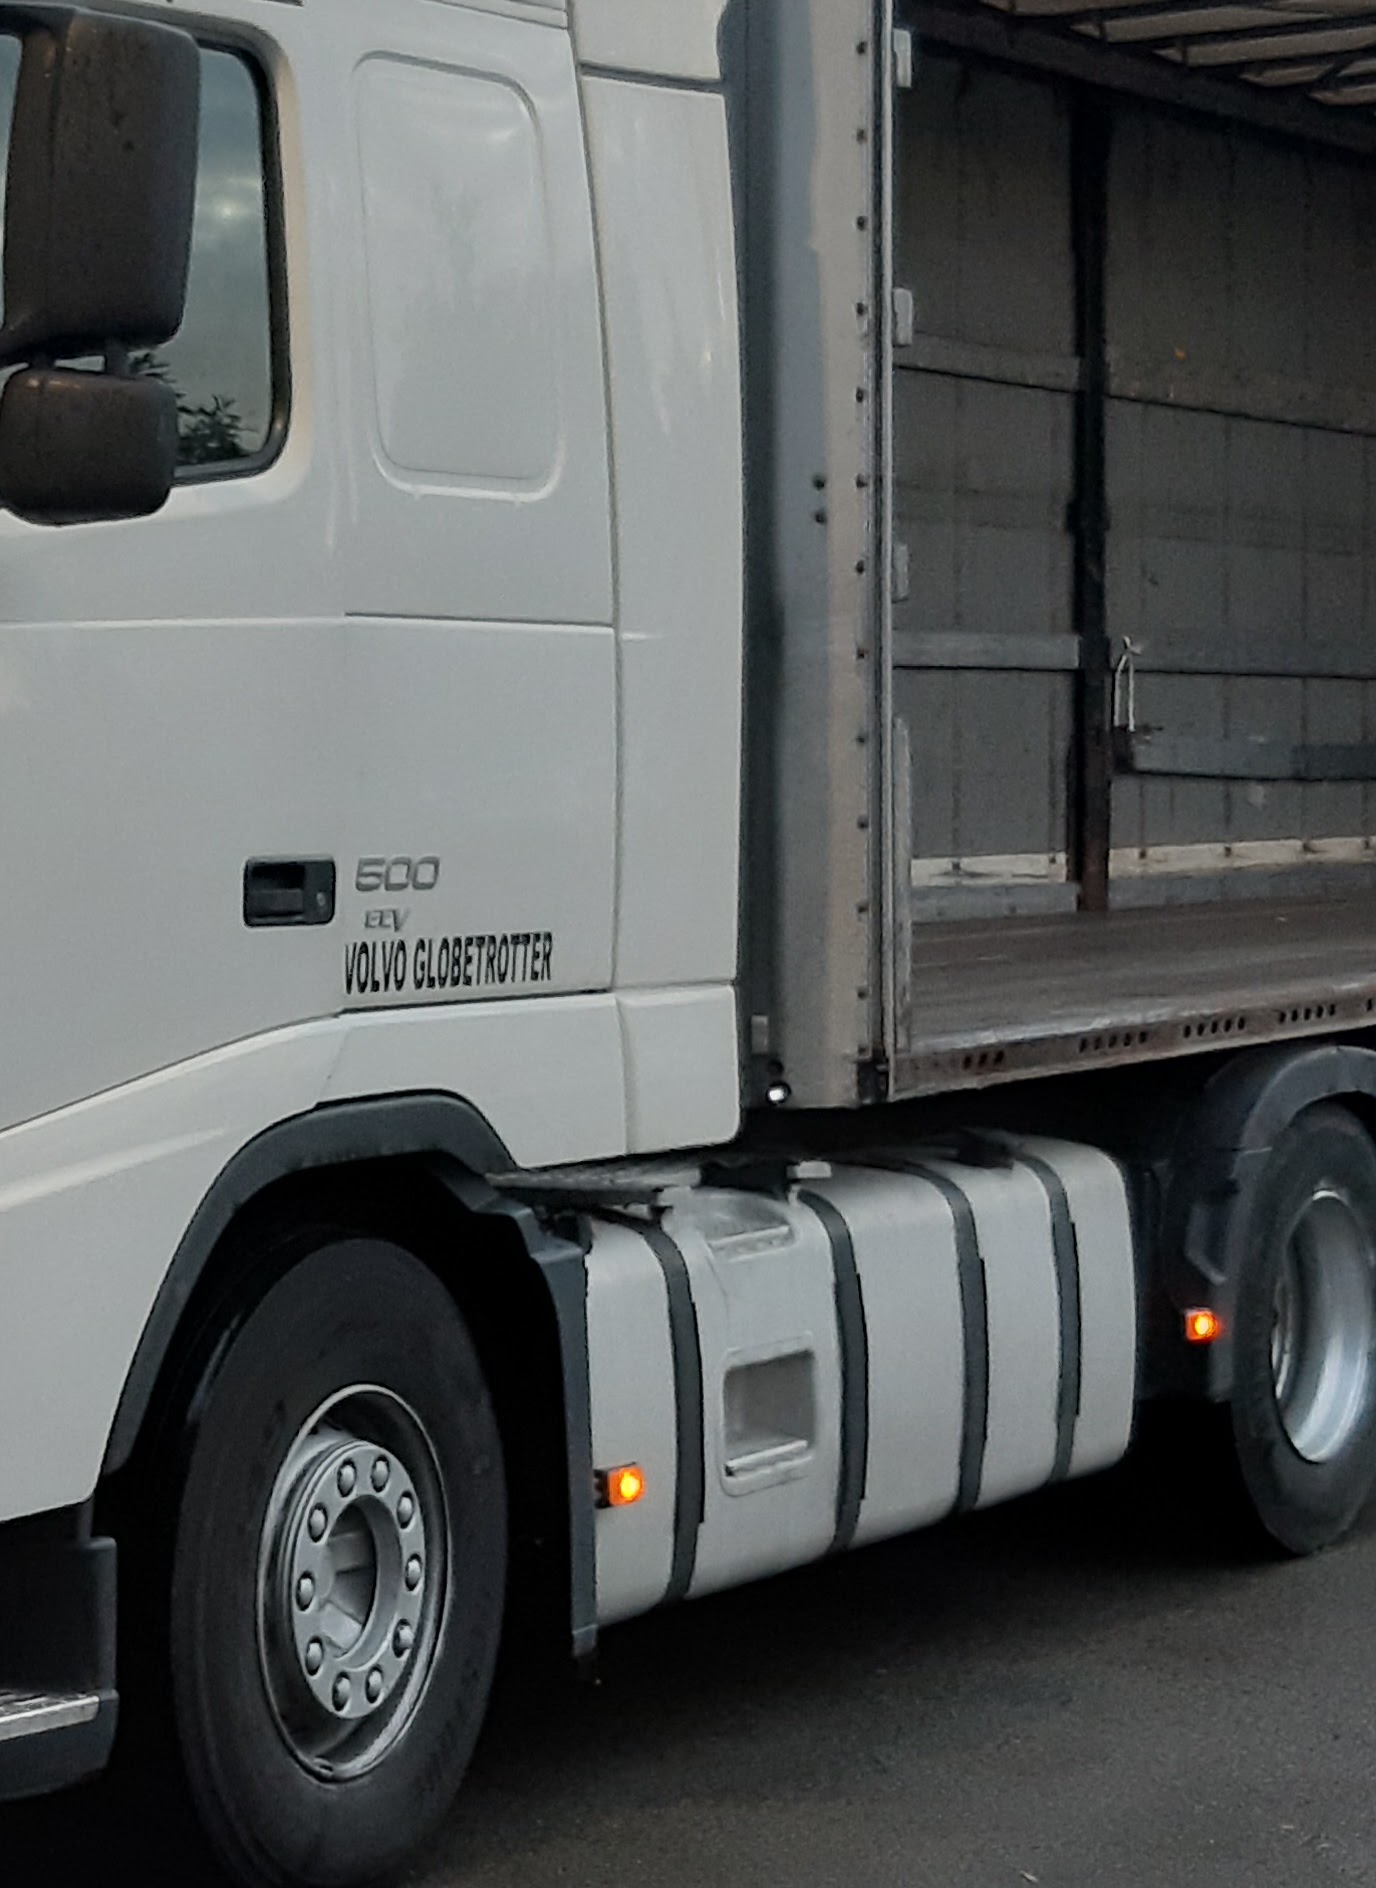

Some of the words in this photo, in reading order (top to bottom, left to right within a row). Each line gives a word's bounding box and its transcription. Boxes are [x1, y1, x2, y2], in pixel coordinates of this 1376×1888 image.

[355, 857, 440, 891] 500
[345, 939, 407, 994] VOLVO
[413, 932, 553, 989] GLOBETROTTER
